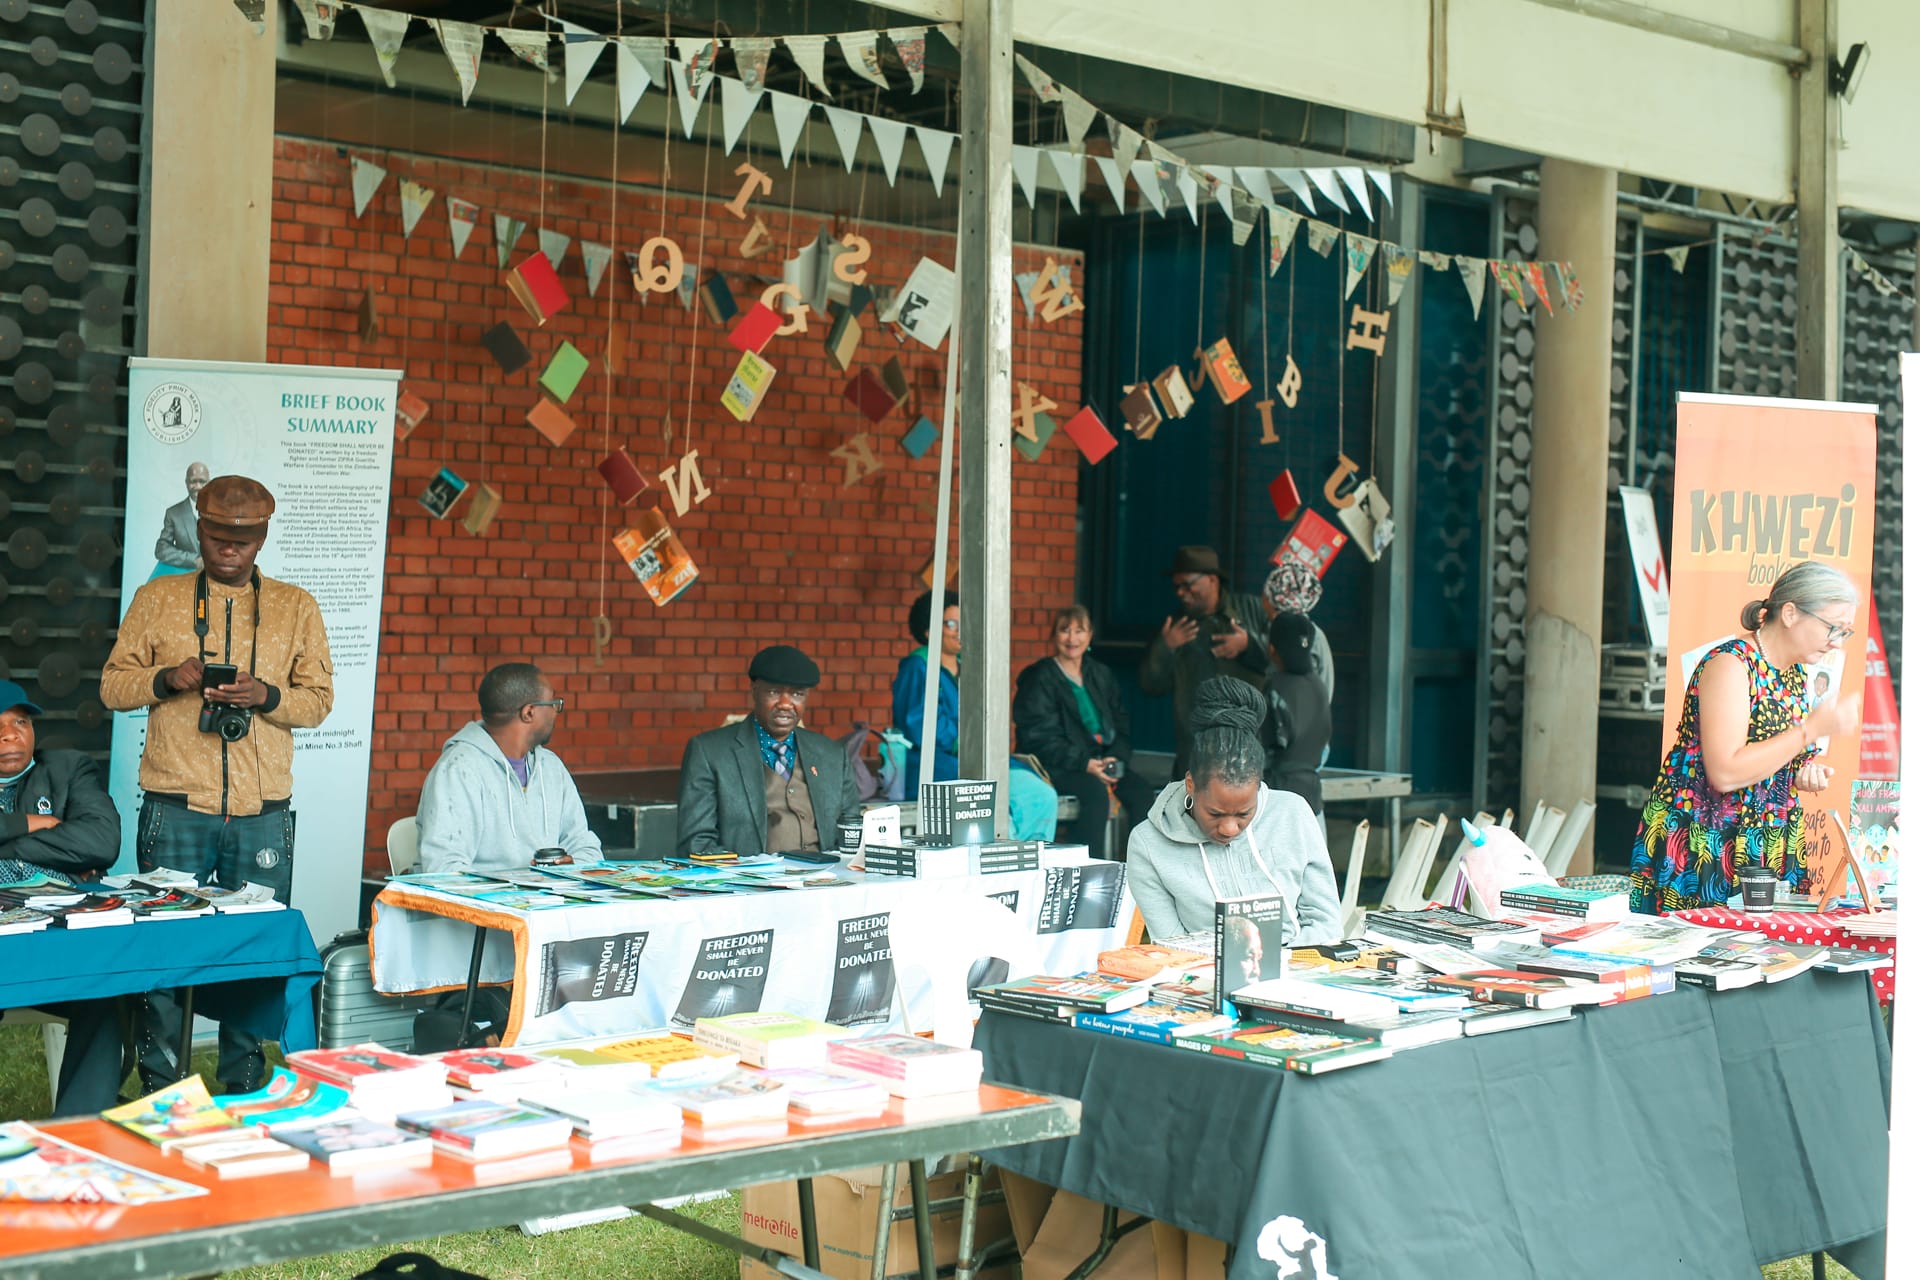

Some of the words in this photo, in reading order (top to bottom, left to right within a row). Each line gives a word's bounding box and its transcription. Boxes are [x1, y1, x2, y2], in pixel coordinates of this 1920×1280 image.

[1346, 304, 1392, 357] H
[1276, 354, 1303, 409] B
[281, 393, 332, 409] BRIEF
[336, 395, 386, 412] BOOK
[287, 416, 378, 435] SUMMARY
[1255, 400, 1280, 445] I
[313, 730, 321, 738] at
[322, 728, 355, 738] midnight
[344, 740, 363, 749] Shaft
[954, 784, 994, 796] FREEDOM
[955, 808, 992, 821] DONATED
[1804, 809, 1827, 837] safe
[1055, 868, 1065, 896] NEVE
[1066, 867, 1081, 926] DONATE
[1052, 896, 1062, 925] SHALL
[1228, 903, 1241, 915] Fit
[1242, 902, 1252, 914] to
[1252, 900, 1281, 912] Govern
[842, 915, 890, 935] FREEDO
[705, 932, 769, 952] FREEDOM
[844, 932, 870, 944] SHALL
[870, 928, 889, 939] NEVE
[706, 950, 734, 961] SHALL
[735, 946, 764, 956] NEVER
[863, 941, 875, 951] BE
[591, 940, 616, 998] DONATED
[610, 963, 620, 974] BE
[622, 936, 645, 994] FREEDOM
[727, 958, 740, 967] BE
[696, 965, 764, 981] DONATED
